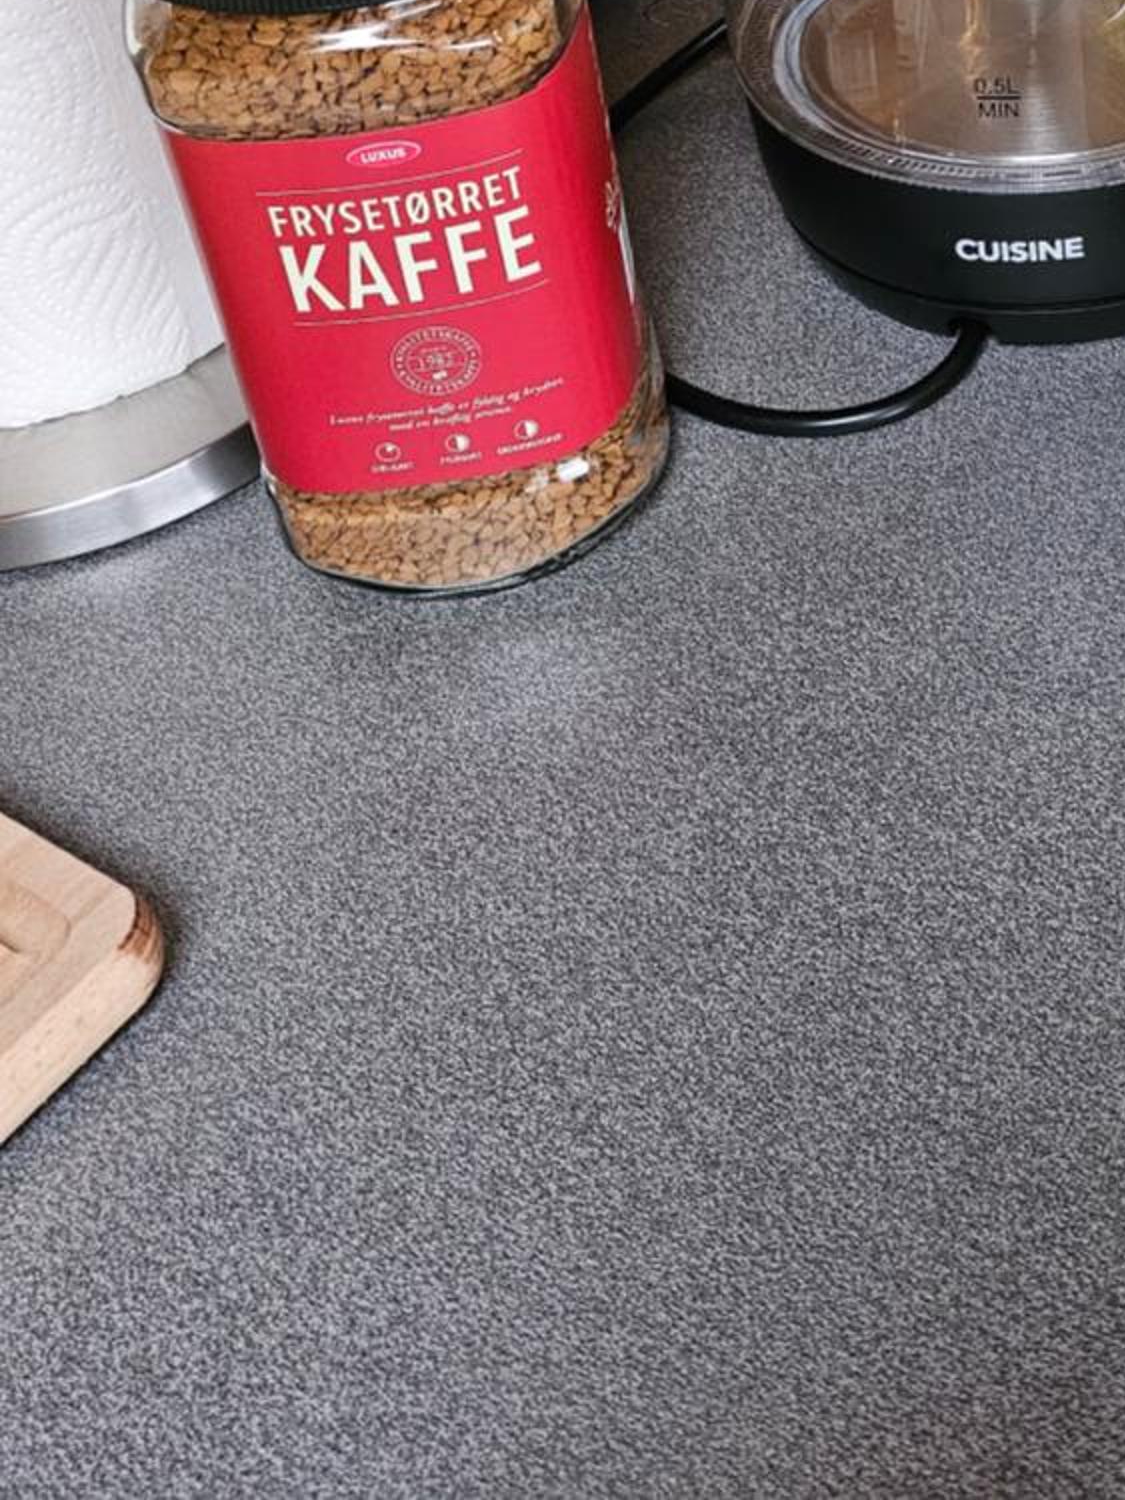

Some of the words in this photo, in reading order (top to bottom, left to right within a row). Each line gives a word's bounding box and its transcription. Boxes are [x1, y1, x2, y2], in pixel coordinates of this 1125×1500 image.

[973, 78, 1020, 95] 0.5L
[976, 103, 1020, 118] MIN
[360, 147, 407, 164] LUXUS
[267, 166, 521, 238] FRYSETØRRET
[279, 205, 542, 313] KAFFE
[954, 236, 1085, 263] CUISINE
